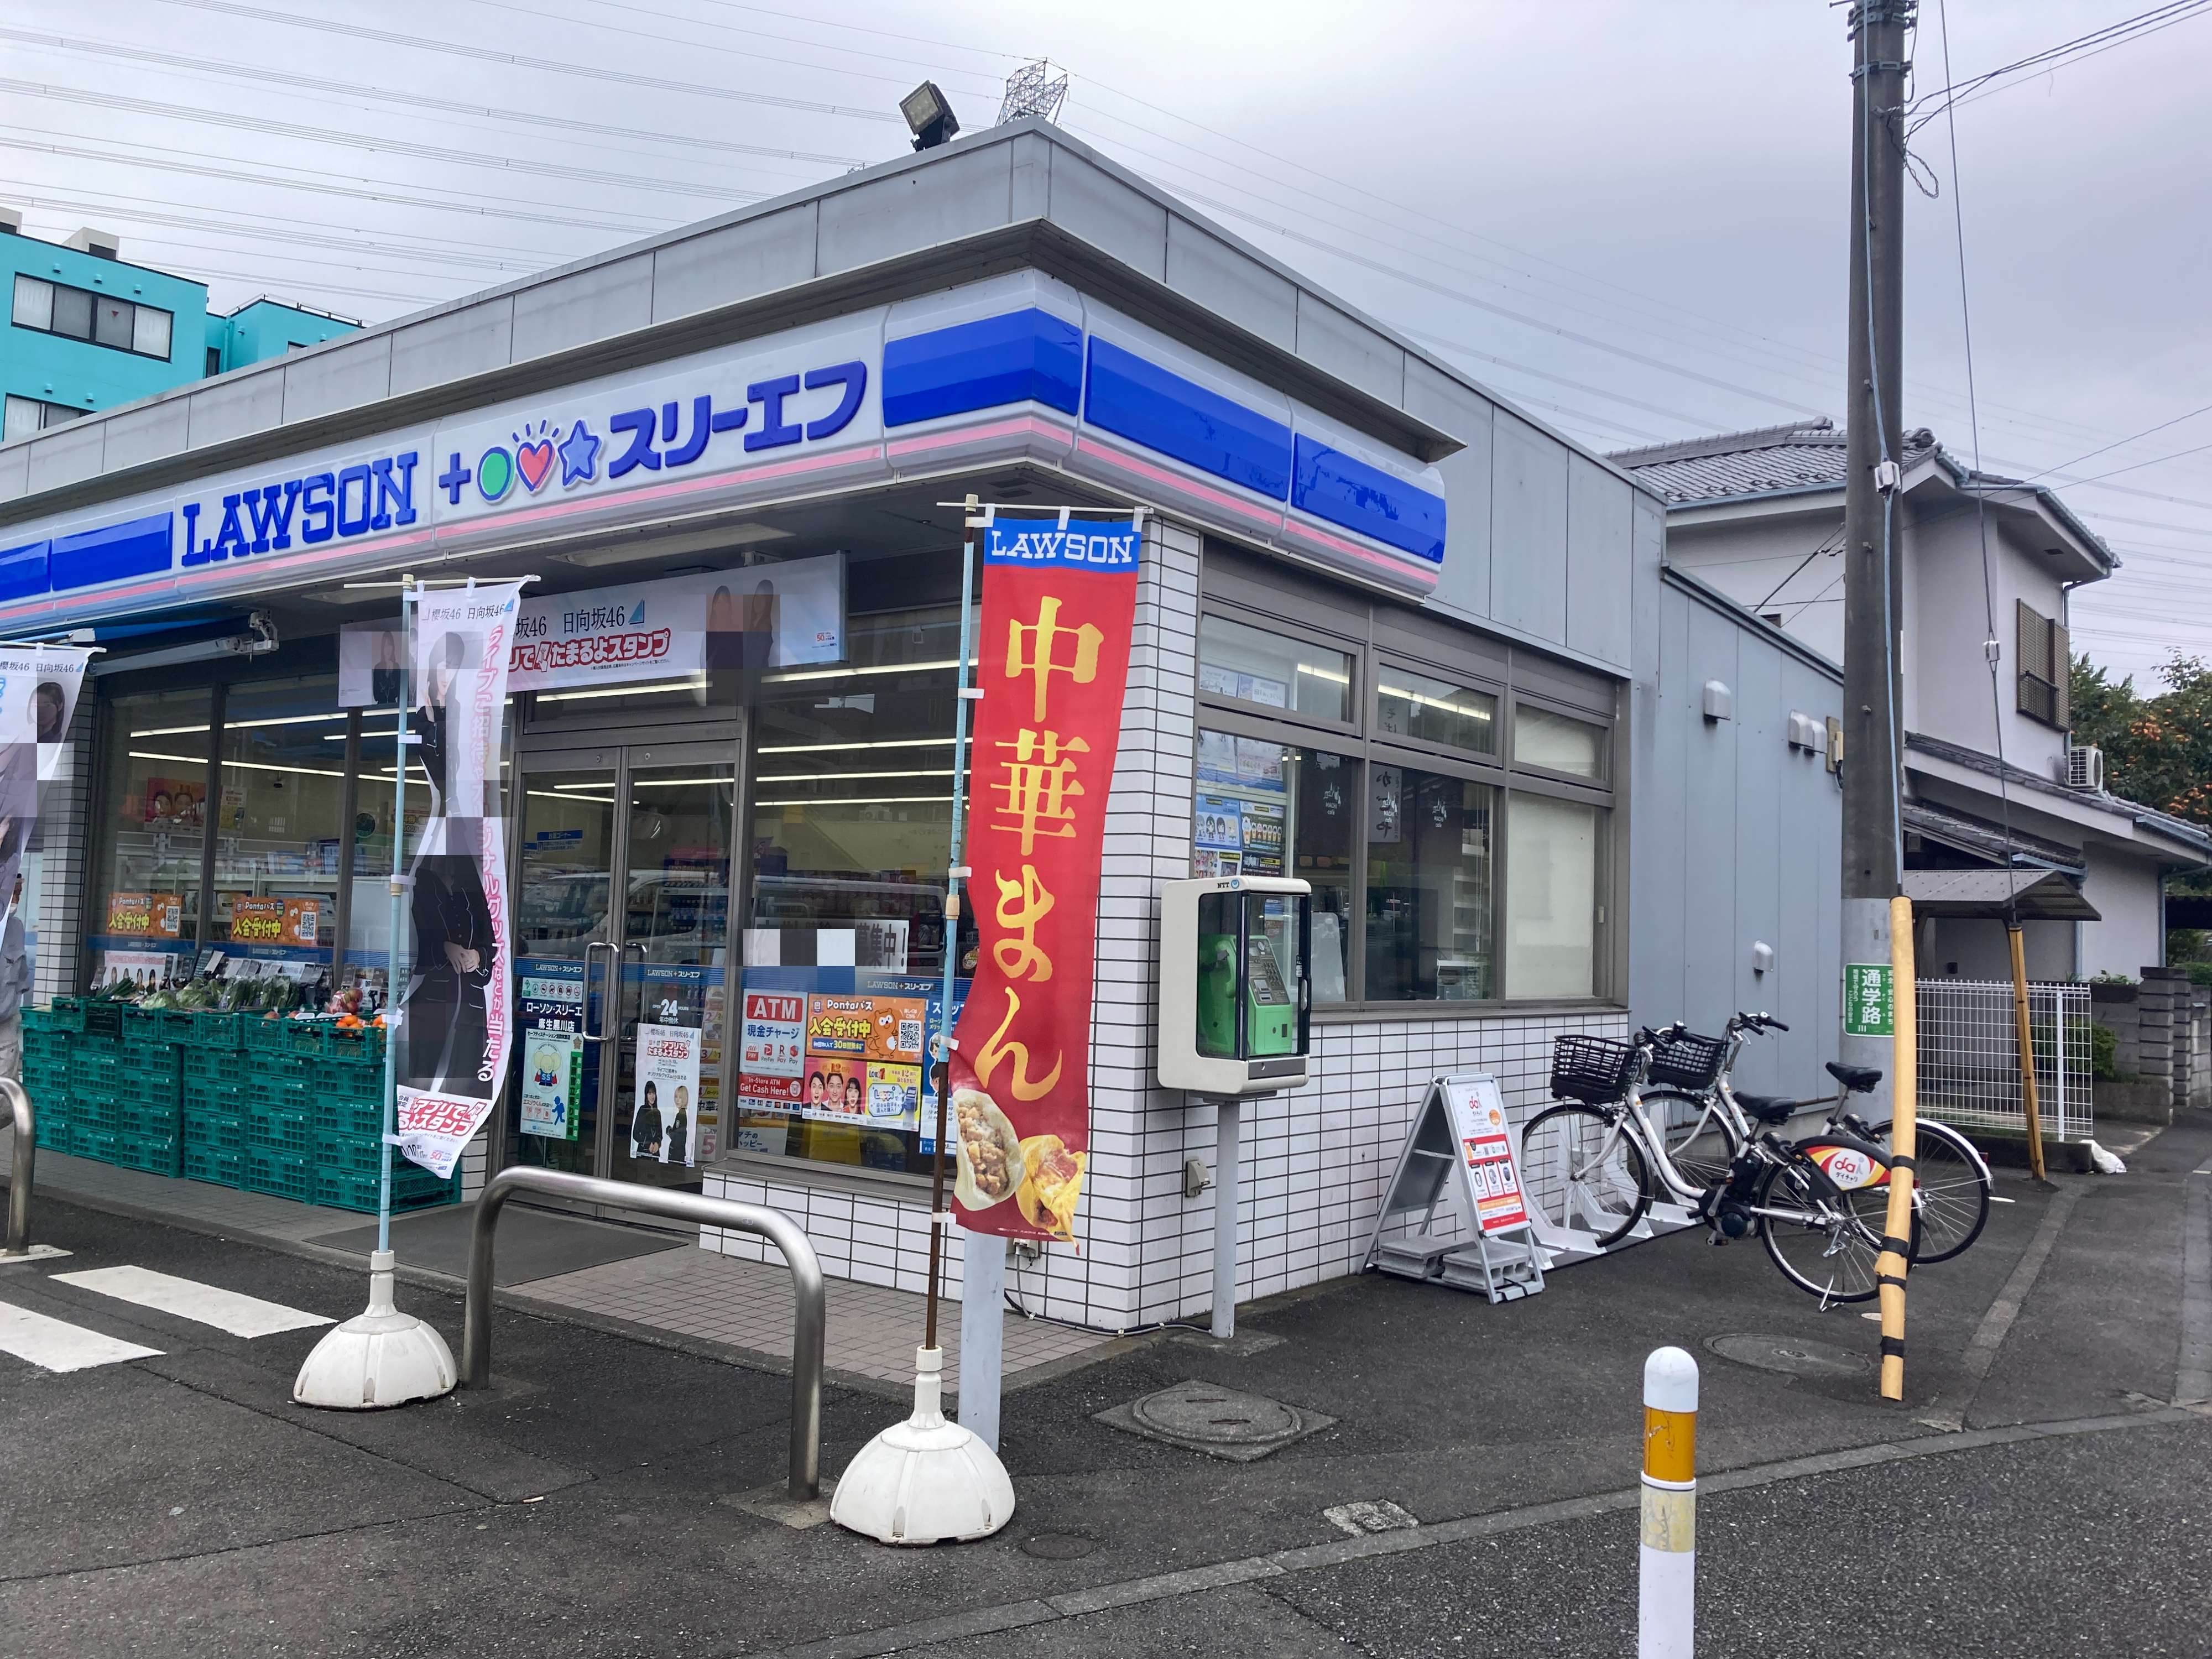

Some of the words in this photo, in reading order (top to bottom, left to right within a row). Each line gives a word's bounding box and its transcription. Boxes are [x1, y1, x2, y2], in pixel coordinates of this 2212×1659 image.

[182, 451, 418, 567] LAWSON
[609, 361, 868, 479] スリーエフ
[991, 530, 1134, 565] LAWSON
[467, 604, 505, 619] 日向坂46
[564, 606, 625, 634] 日向坂46
[551, 628, 671, 667] たまるよスタンプ
[35, 663, 74, 673] 日向坂46
[974, 596, 1104, 1101] 中華まん
[245, 901, 275, 911] Pontaパス
[109, 911, 150, 931] 入会受付中
[233, 916, 281, 938] 入会受付中
[868, 980, 898, 989] LAWSON
[827, 999, 873, 1011] Pontaパス
[1862, 968, 1881, 1024] 通学路
[526, 1002, 582, 1016] ローソン・スリーエ
[661, 999, 678, 1016] 24
[753, 998, 796, 1020] ATM
[932, 1002, 965, 1015] スッ
[747, 1024, 799, 1039] 現金チャージ
[809, 1016, 872, 1039] 入会受付中
[740, 1083, 751, 1093] Get
[753, 1084, 769, 1094] Cash
[770, 1087, 789, 1096] Here!
[415, 1098, 470, 1120] アプリで
[1835, 1172, 1858, 1182] ダイチャリ
